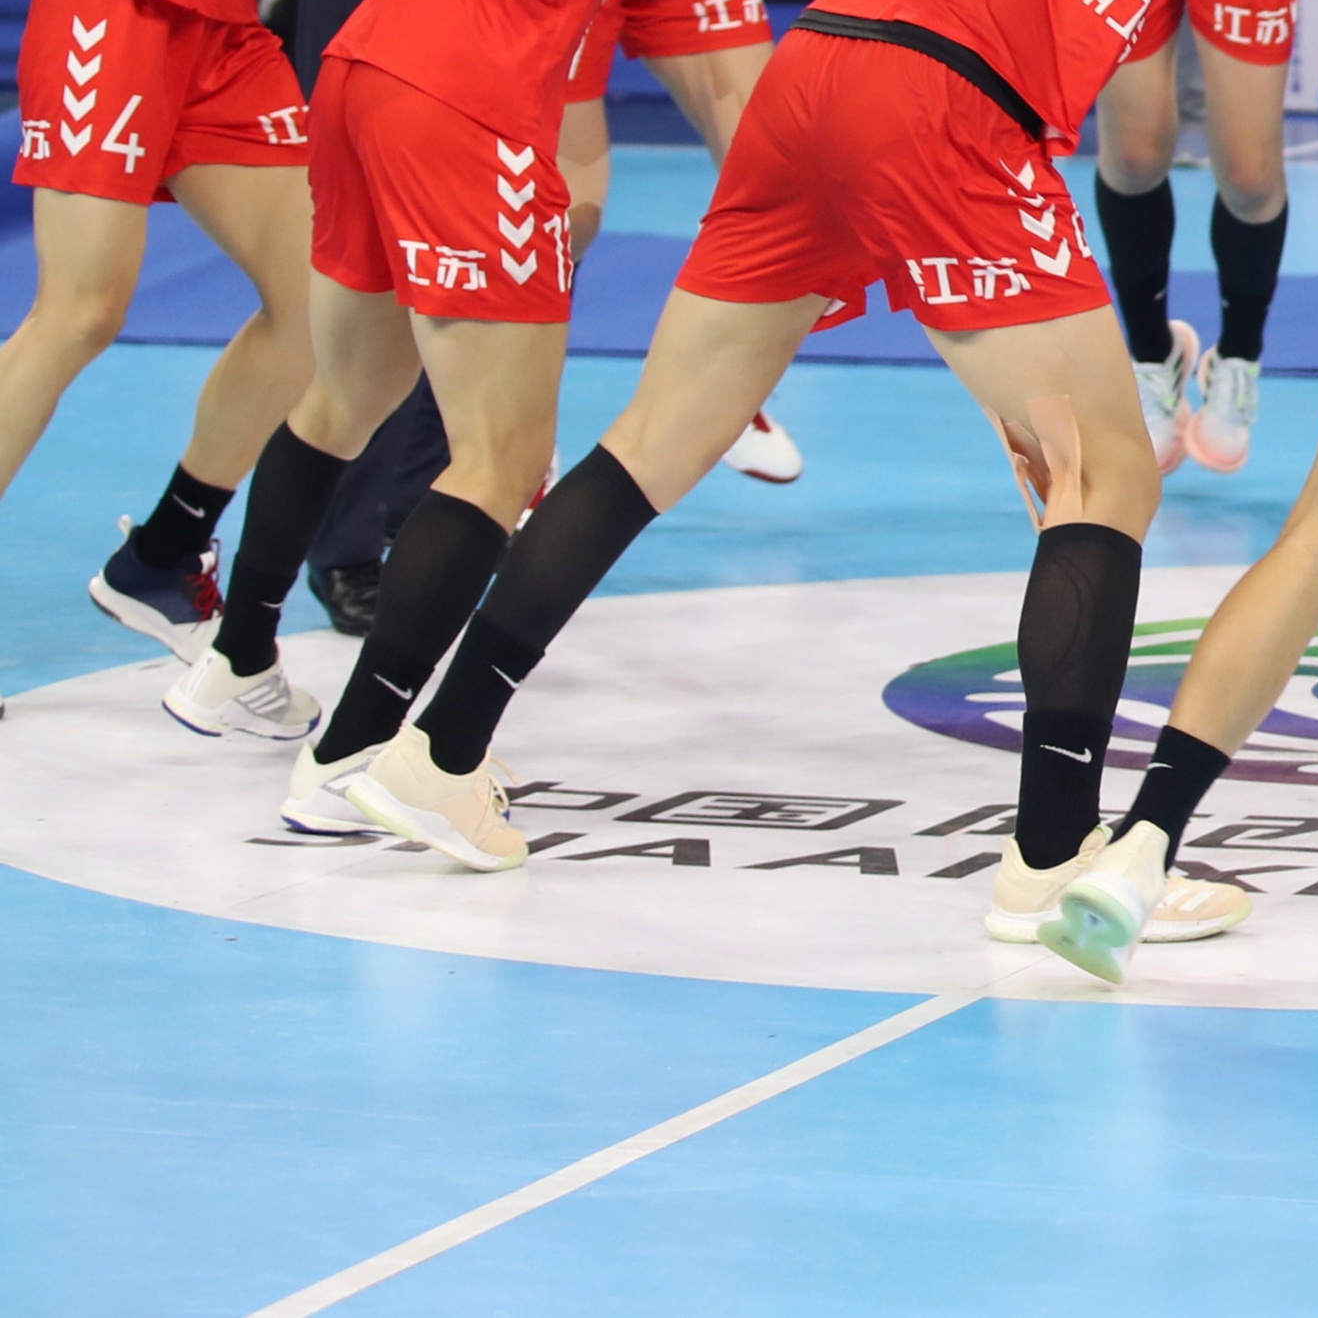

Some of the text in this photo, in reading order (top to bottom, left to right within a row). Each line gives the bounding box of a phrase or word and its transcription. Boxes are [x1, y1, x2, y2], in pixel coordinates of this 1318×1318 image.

[1213, 2, 1290, 46] 江苏
[100, 94, 146, 174] 4
[257, 105, 310, 145] 江
[906, 256, 1032, 305] 江苏
